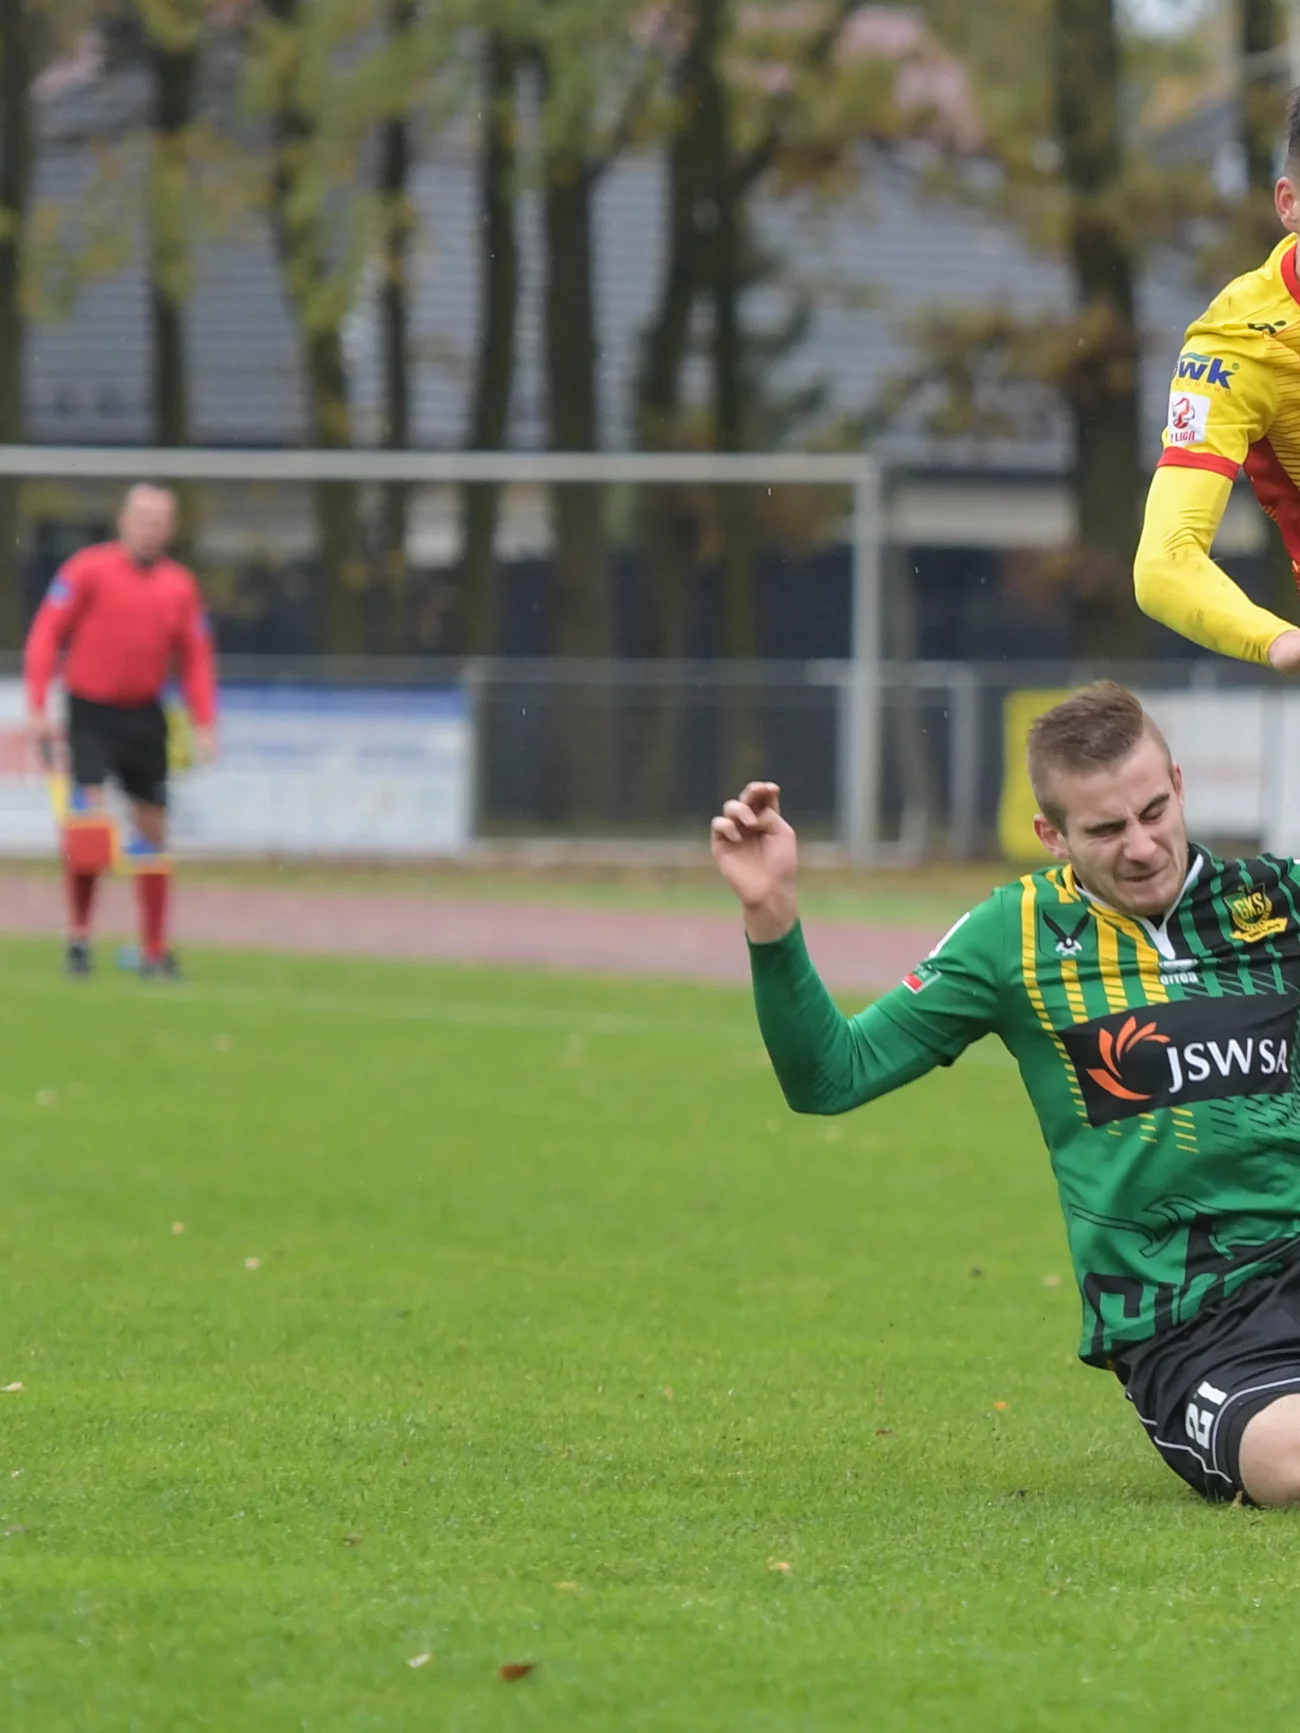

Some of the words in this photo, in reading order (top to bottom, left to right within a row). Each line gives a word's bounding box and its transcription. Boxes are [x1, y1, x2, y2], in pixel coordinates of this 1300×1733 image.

[1233, 892, 1265, 920] GKS
[1166, 1038, 1254, 1094] JSW
[1258, 1039, 1289, 1075] SA
[1185, 1380, 1229, 1450] 21
